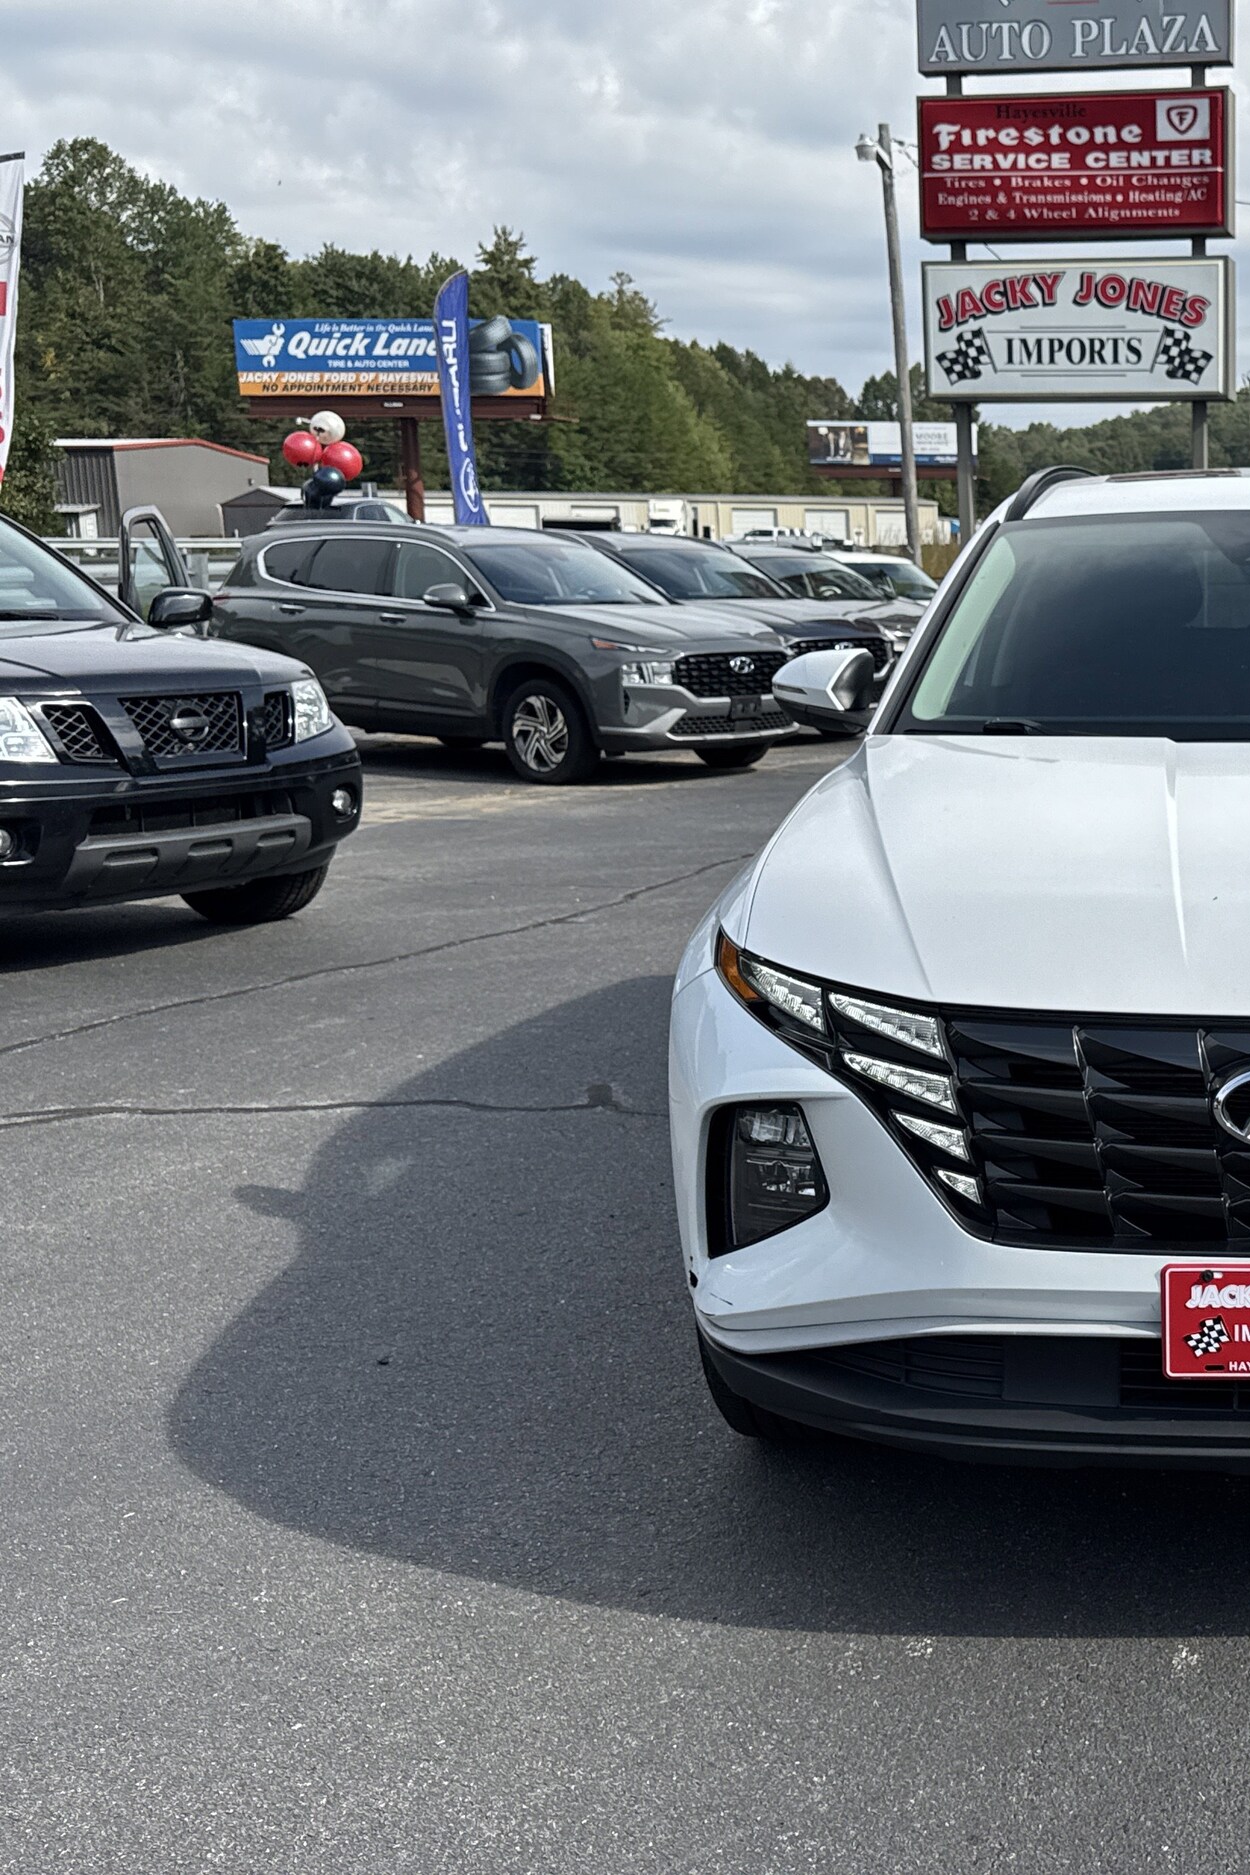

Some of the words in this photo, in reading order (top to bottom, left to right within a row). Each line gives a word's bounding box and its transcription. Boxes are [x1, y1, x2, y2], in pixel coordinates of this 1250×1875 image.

[928, 20, 1052, 63] AUTO
[1071, 14, 1220, 56] PLAZA
[995, 103, 1087, 123] Hayesville
[932, 123, 1143, 151] Firestone
[931, 152, 1071, 170] SERVICE
[1085, 148, 1213, 169] CENTER
[944, 177, 986, 188] Tires
[1010, 176, 1071, 188] Brakes
[1095, 175, 1124, 187] Oil
[1131, 175, 1210, 188] Changes
[937, 192, 992, 207] Engines
[996, 192, 1008, 205] &
[1012, 190, 1112, 204] Transmissions
[968, 208, 979, 221] 2
[985, 208, 999, 221] &
[1006, 209, 1016, 220] 4
[1023, 207, 1077, 220] Wheel
[1084, 205, 1181, 222] Alignments
[936, 271, 1066, 332] JACKY
[1073, 271, 1212, 329] JONES
[314, 322, 331, 333] Life
[340, 322, 366, 333] Better
[387, 322, 412, 334] Quick
[287, 330, 372, 359] Quick
[1005, 336, 1143, 366] IMPORTS
[327, 359, 346, 369] TIRE
[353, 359, 376, 368] AUTO
[376, 359, 410, 369] CENTER
[238, 372, 280, 384] JACKY
[280, 372, 321, 384] JONES
[323, 372, 357, 383] FORD
[359, 372, 377, 383] OF
[378, 372, 440, 384] HAYESVILL
[262, 383, 279, 393] NO
[282, 383, 363, 393] APPOINTMENT
[367, 383, 434, 393] NECESSARY
